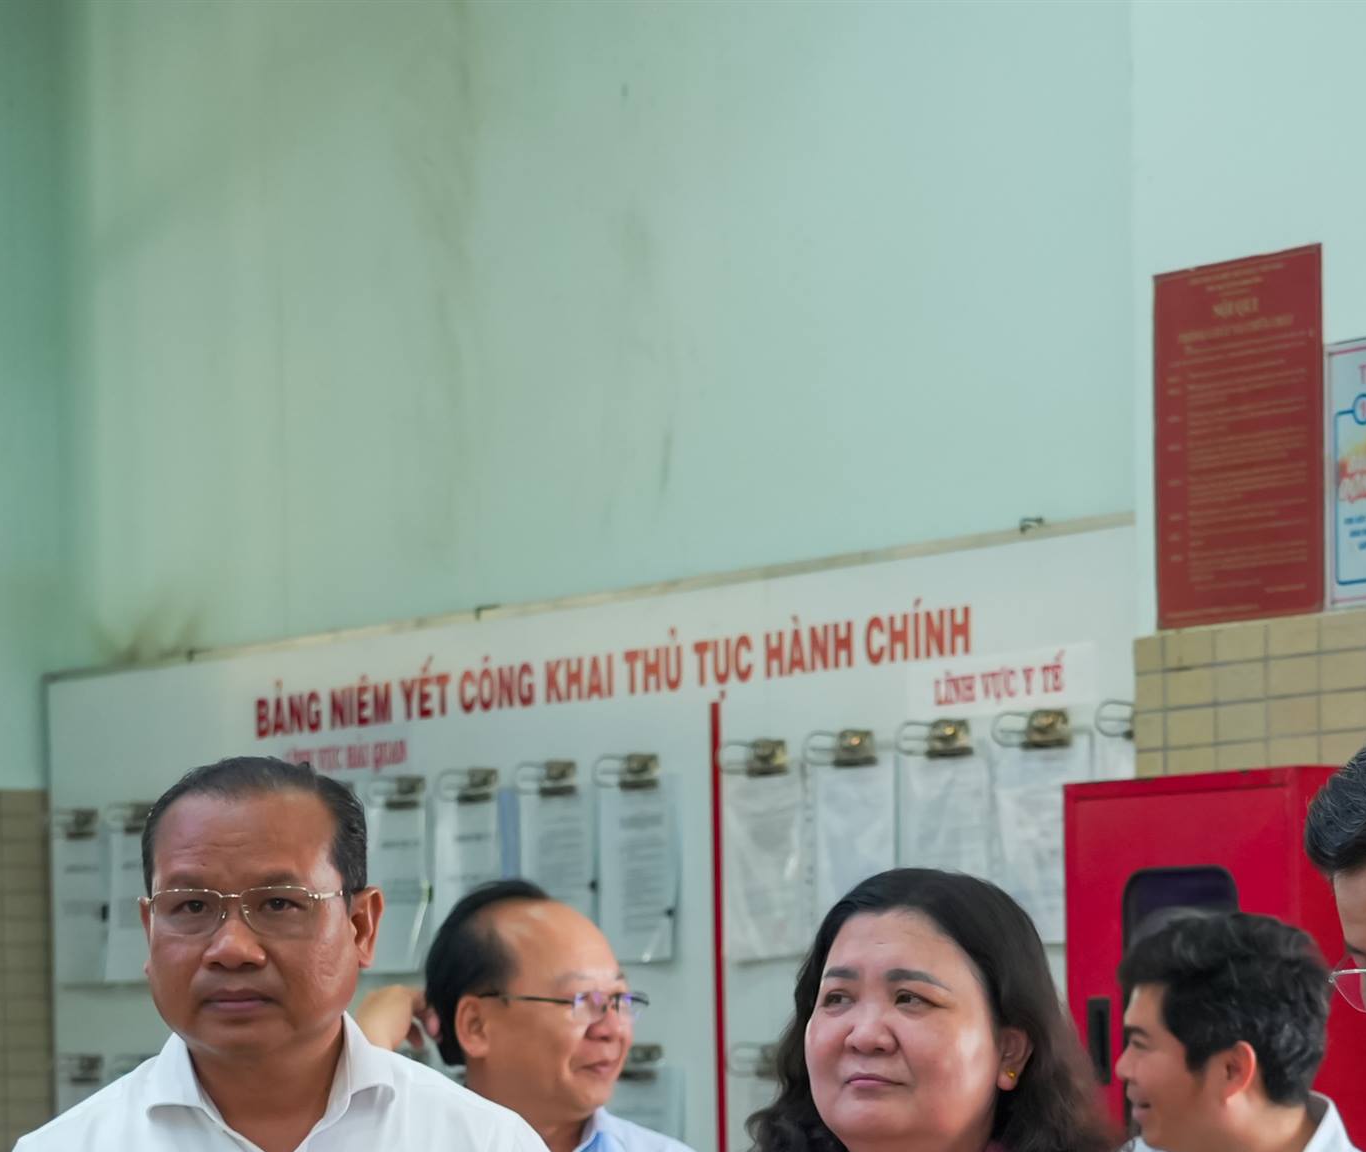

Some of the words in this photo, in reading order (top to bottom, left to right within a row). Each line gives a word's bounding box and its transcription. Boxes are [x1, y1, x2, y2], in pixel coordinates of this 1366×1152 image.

[255, 679, 322, 740] BẢNG
[330, 674, 392, 730] NIÊM
[400, 655, 450, 721] YẾT
[459, 656, 534, 715] CÔNG
[545, 653, 614, 704] KHAI
[624, 626, 682, 695] THỦ
[693, 634, 752, 701] TỤC
[764, 615, 853, 679] HÀNH
[865, 599, 971, 665] CHÍNH
